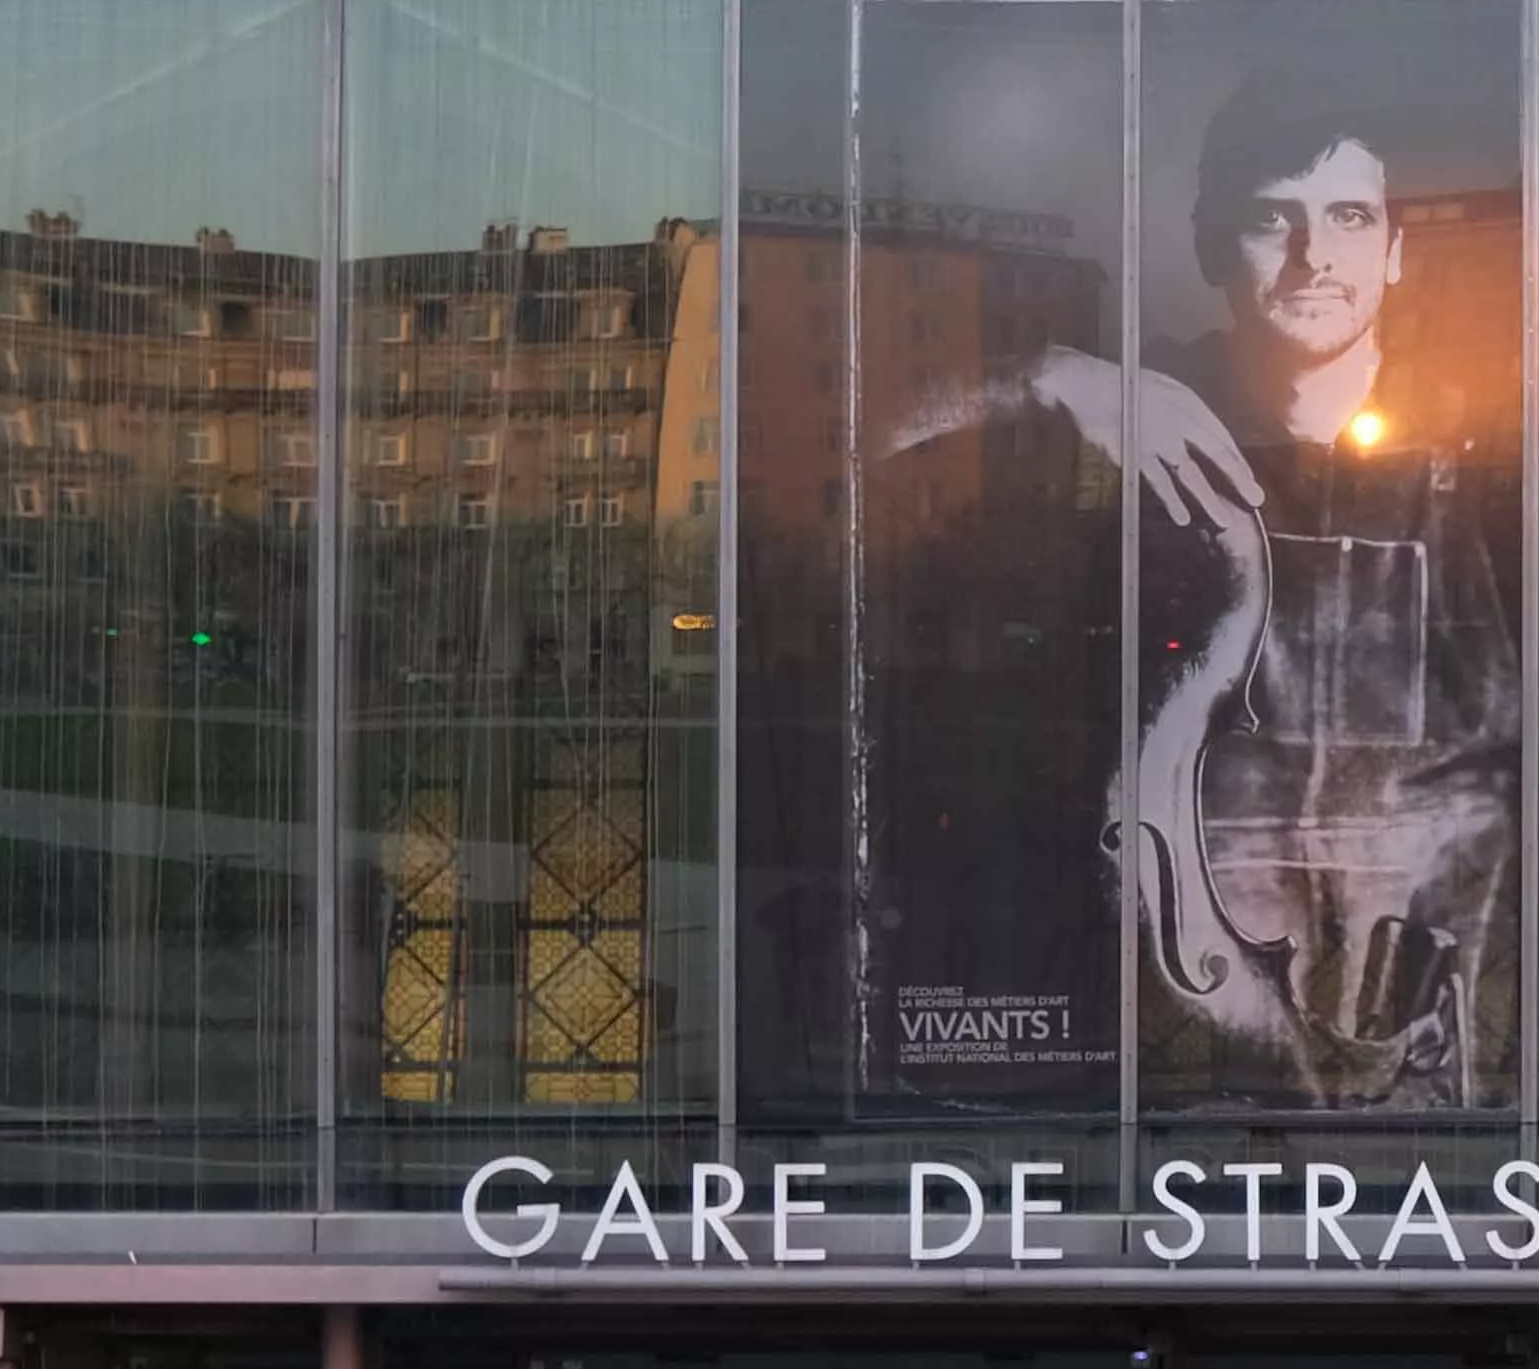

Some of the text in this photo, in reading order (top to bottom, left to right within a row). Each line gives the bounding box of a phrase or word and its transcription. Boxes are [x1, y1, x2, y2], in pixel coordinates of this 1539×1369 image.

[898, 998, 913, 1009] LA
[967, 997, 989, 1008] DES
[899, 1009, 1071, 1041] VIVANTS !
[1013, 1051, 1036, 1063] DES
[461, 1155, 827, 1262] GARE
[910, 1161, 1064, 1262] DE
